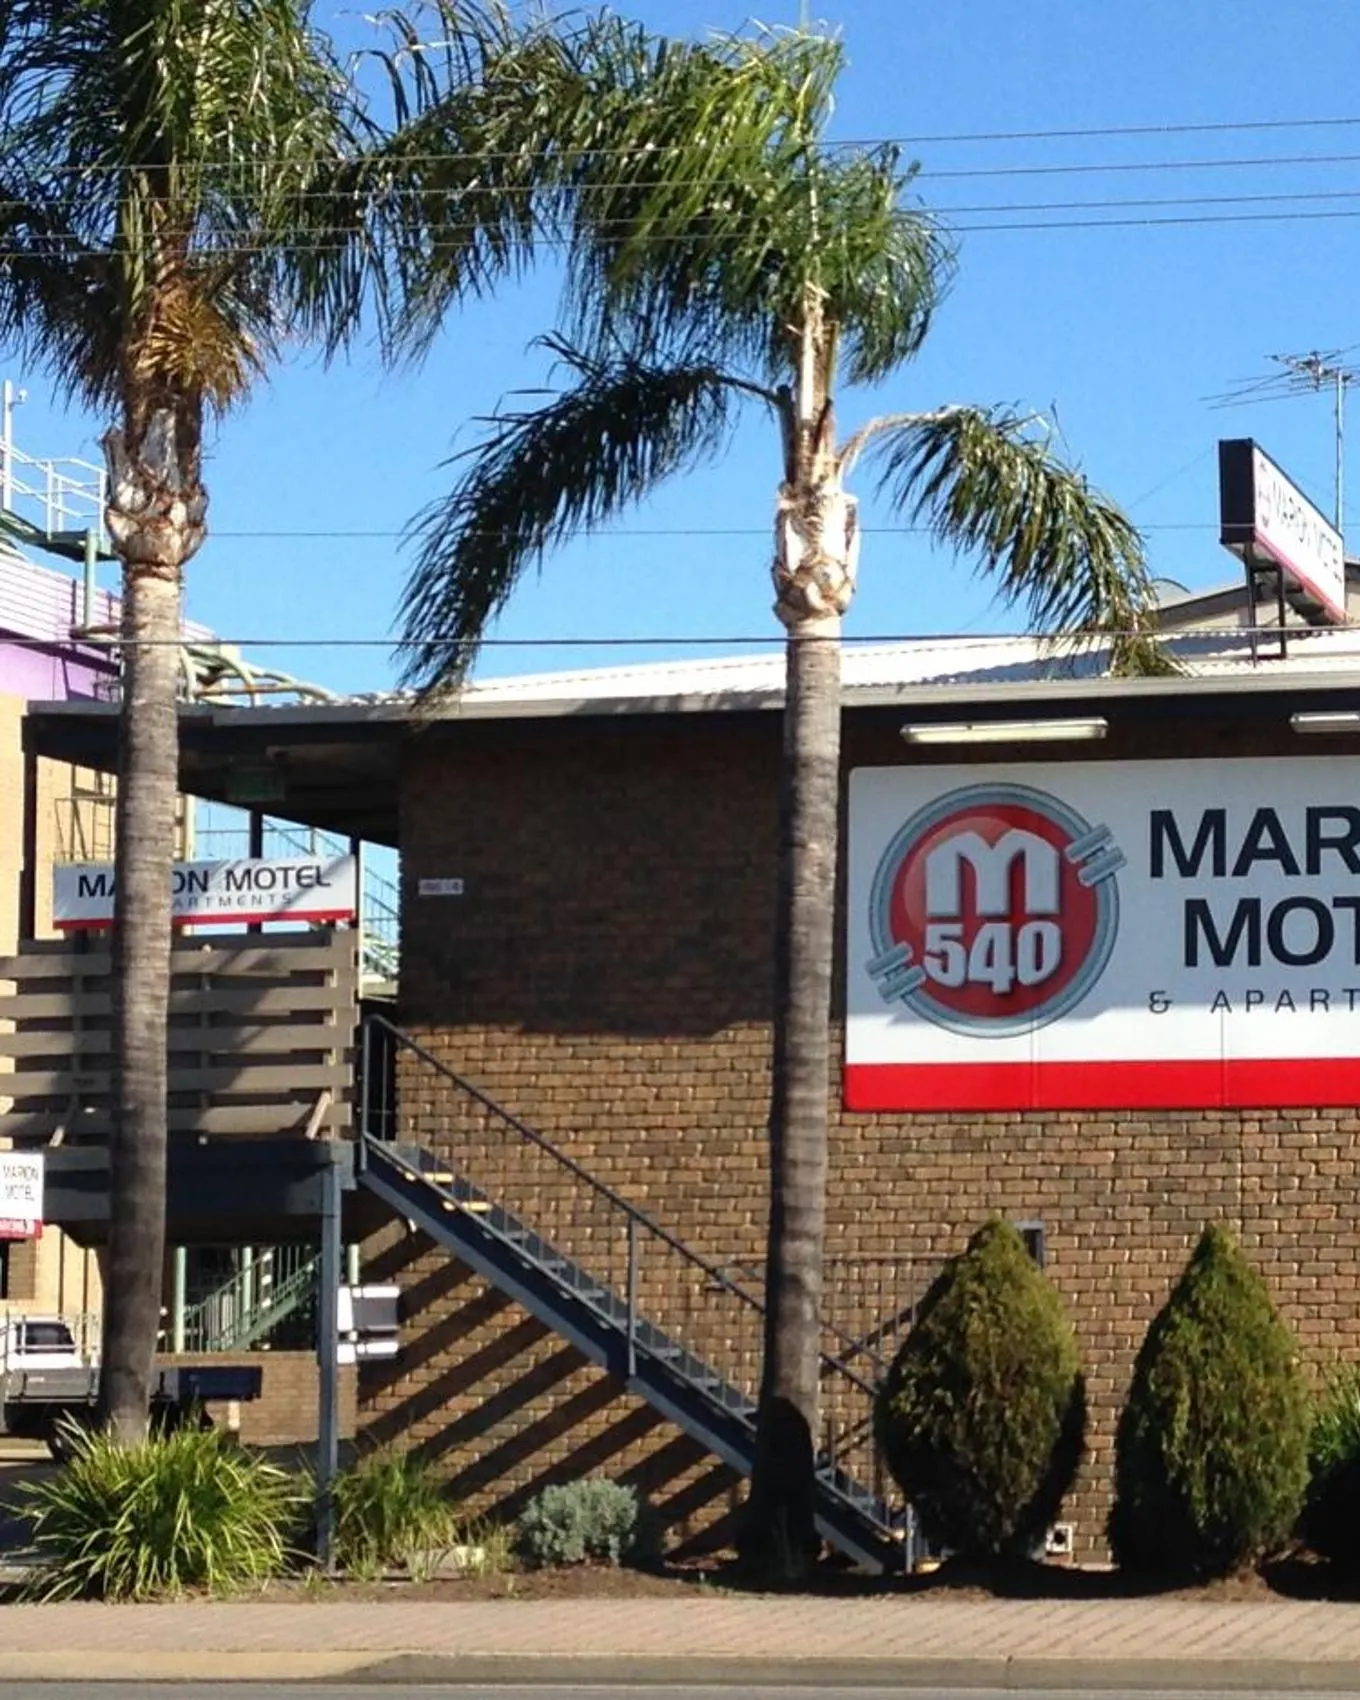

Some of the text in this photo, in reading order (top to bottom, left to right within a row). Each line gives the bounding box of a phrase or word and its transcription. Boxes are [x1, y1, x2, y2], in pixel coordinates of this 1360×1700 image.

[78, 864, 333, 898] MON MOTEL
[922, 919, 1062, 994] 540
[1147, 990, 1174, 1014] &
